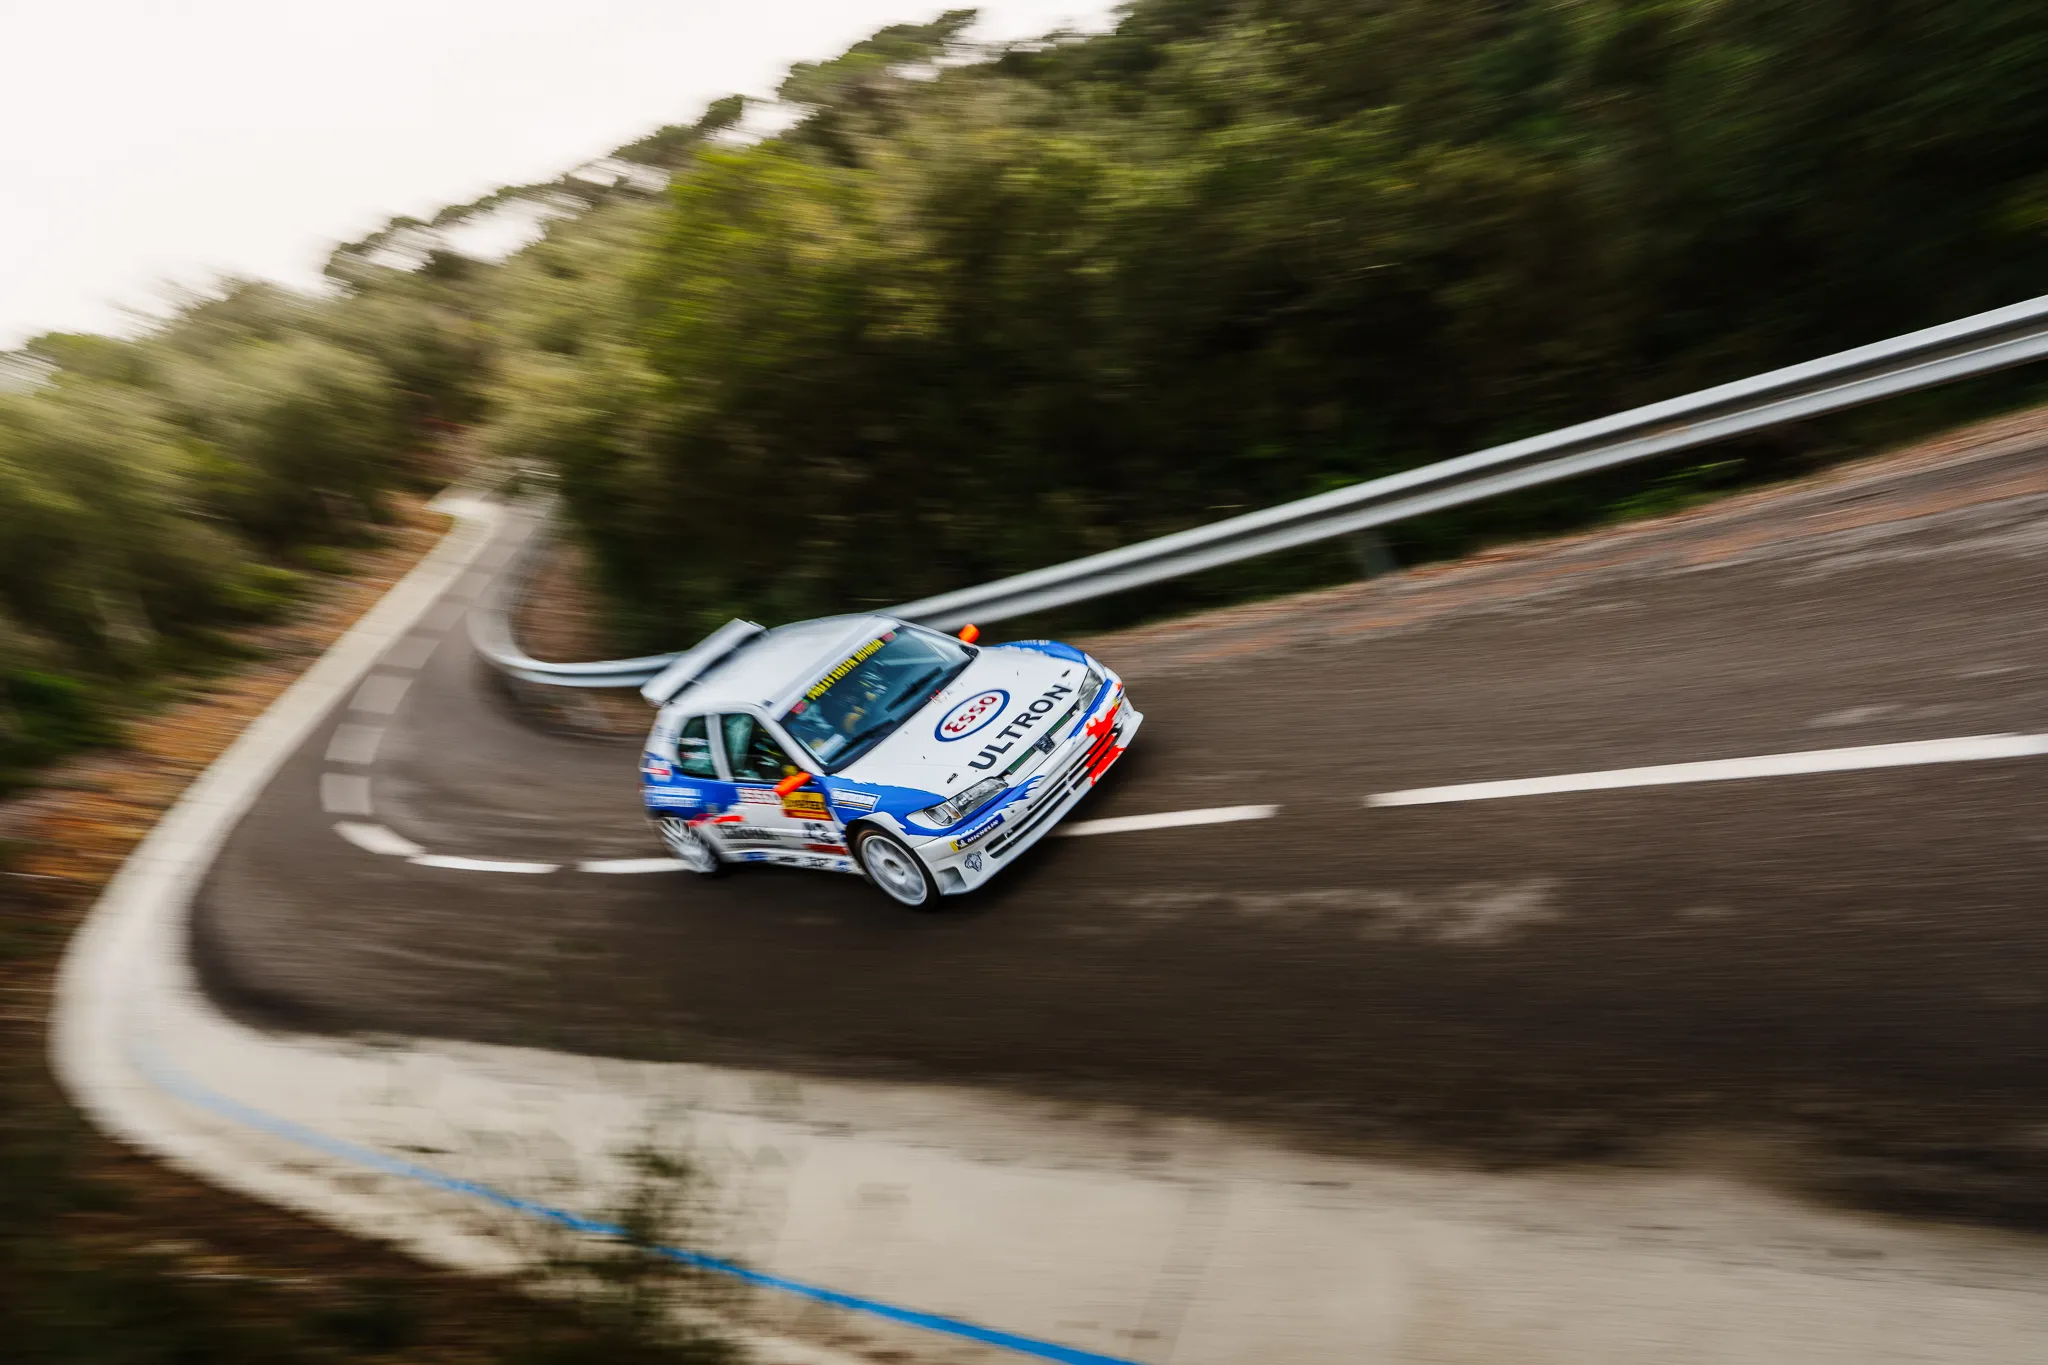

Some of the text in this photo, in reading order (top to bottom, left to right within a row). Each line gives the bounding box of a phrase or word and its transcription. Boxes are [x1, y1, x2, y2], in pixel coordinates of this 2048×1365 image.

[945, 694, 998, 733] ESSO
[968, 683, 1074, 770] ULTRON
[967, 819, 999, 843] MICHELIN
